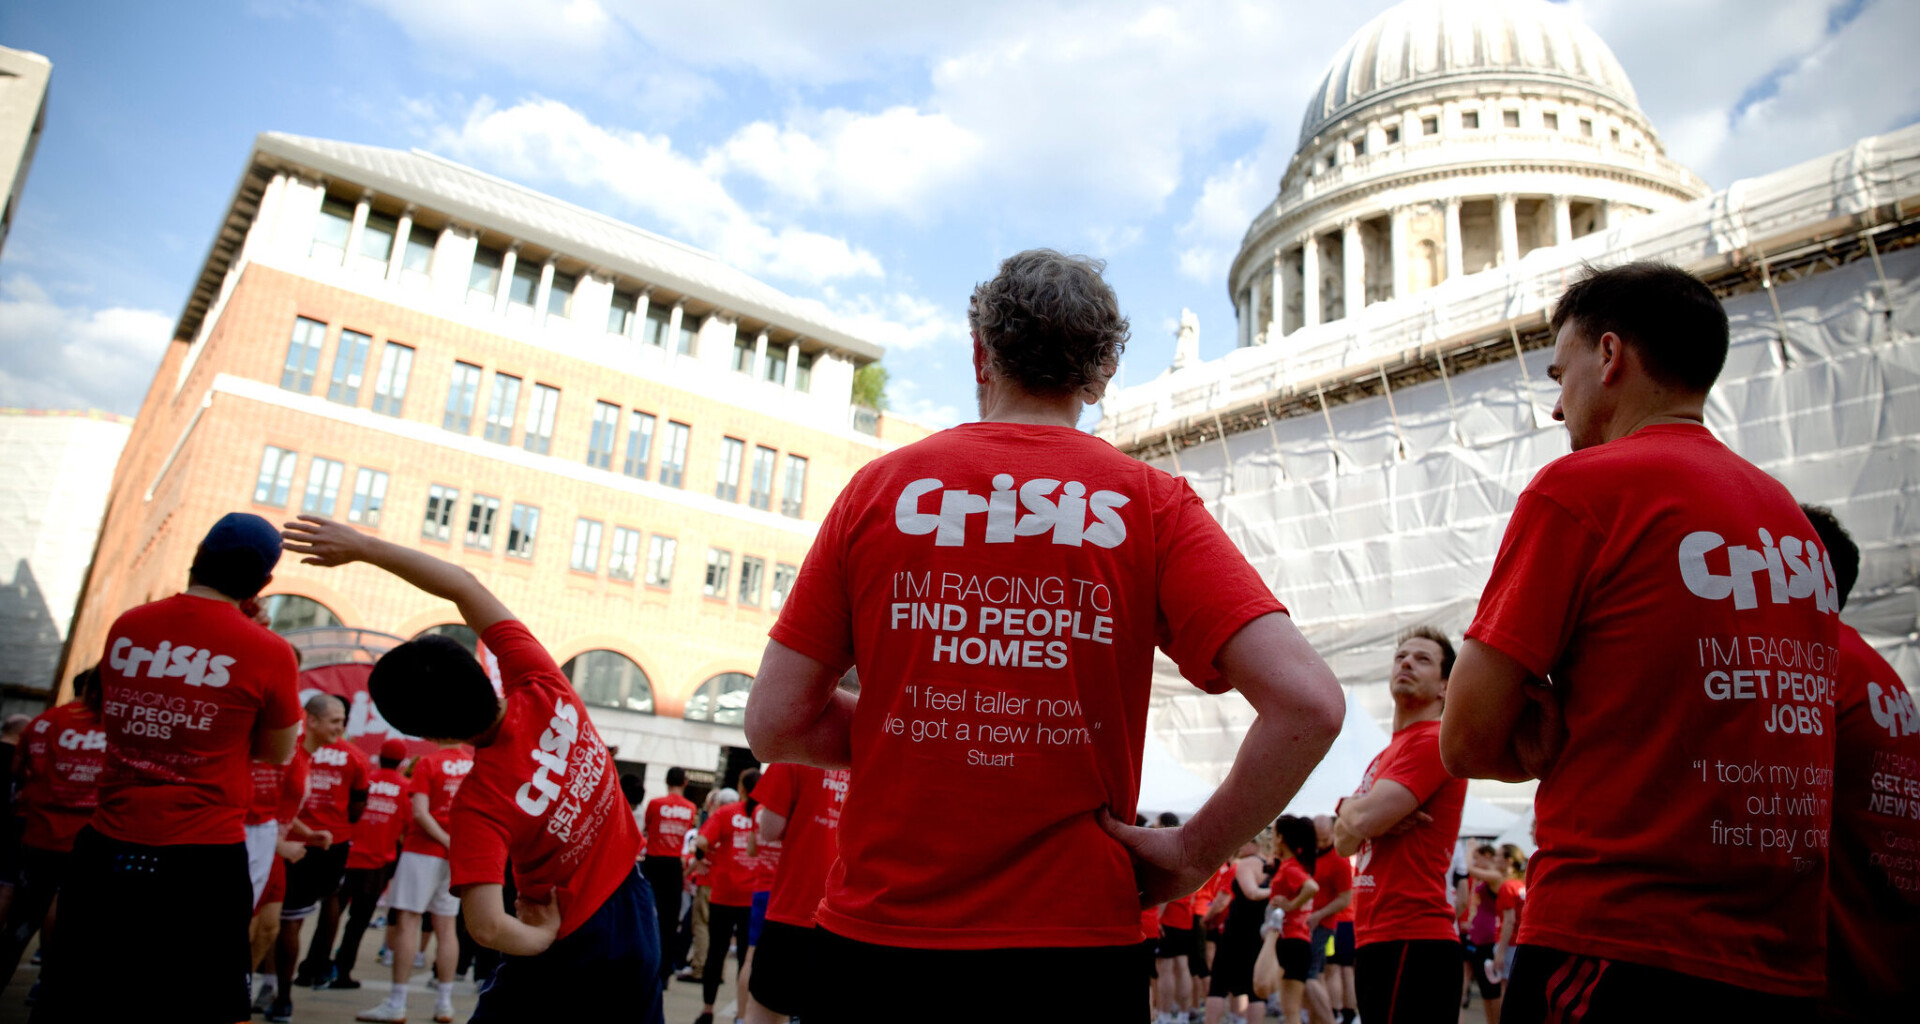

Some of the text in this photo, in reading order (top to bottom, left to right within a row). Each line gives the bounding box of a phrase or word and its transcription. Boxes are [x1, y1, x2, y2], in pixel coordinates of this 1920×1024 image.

[895, 474, 1131, 549] Crisis
[893, 571, 1111, 612] I'M RACING TO
[891, 602, 1114, 645] FIND PEOPLE
[110, 637, 237, 687] Crisis
[933, 634, 1068, 670] HOMES
[1698, 636, 1740, 667] I'M
[1748, 636, 1825, 671] RACING
[924, 686, 966, 712] feel
[974, 691, 1031, 715] taller
[1703, 669, 1771, 700] GET
[132, 705, 213, 732] PEOPLE
[192, 699, 219, 717] TO
[1764, 703, 1824, 736] JOBS
[1867, 681, 1920, 739] Cris
[121, 720, 172, 740] JOBS
[911, 718, 949, 743] got
[955, 722, 971, 741] a
[977, 724, 1030, 745] new
[515, 696, 578, 818] Crisis
[579, 742, 607, 803] SKILLS
[967, 749, 1015, 767] Stuart
[547, 730, 600, 835] GET PEOPLE
[822, 778, 848, 793] FIND
[1715, 760, 1764, 783] took
[1769, 765, 1799, 790] my
[1871, 771, 1901, 795] GET
[1747, 792, 1782, 816] out
[1786, 793, 1819, 816] with
[1868, 793, 1908, 818] NEW
[1710, 820, 1752, 847] first
[1760, 828, 1797, 853] pay
